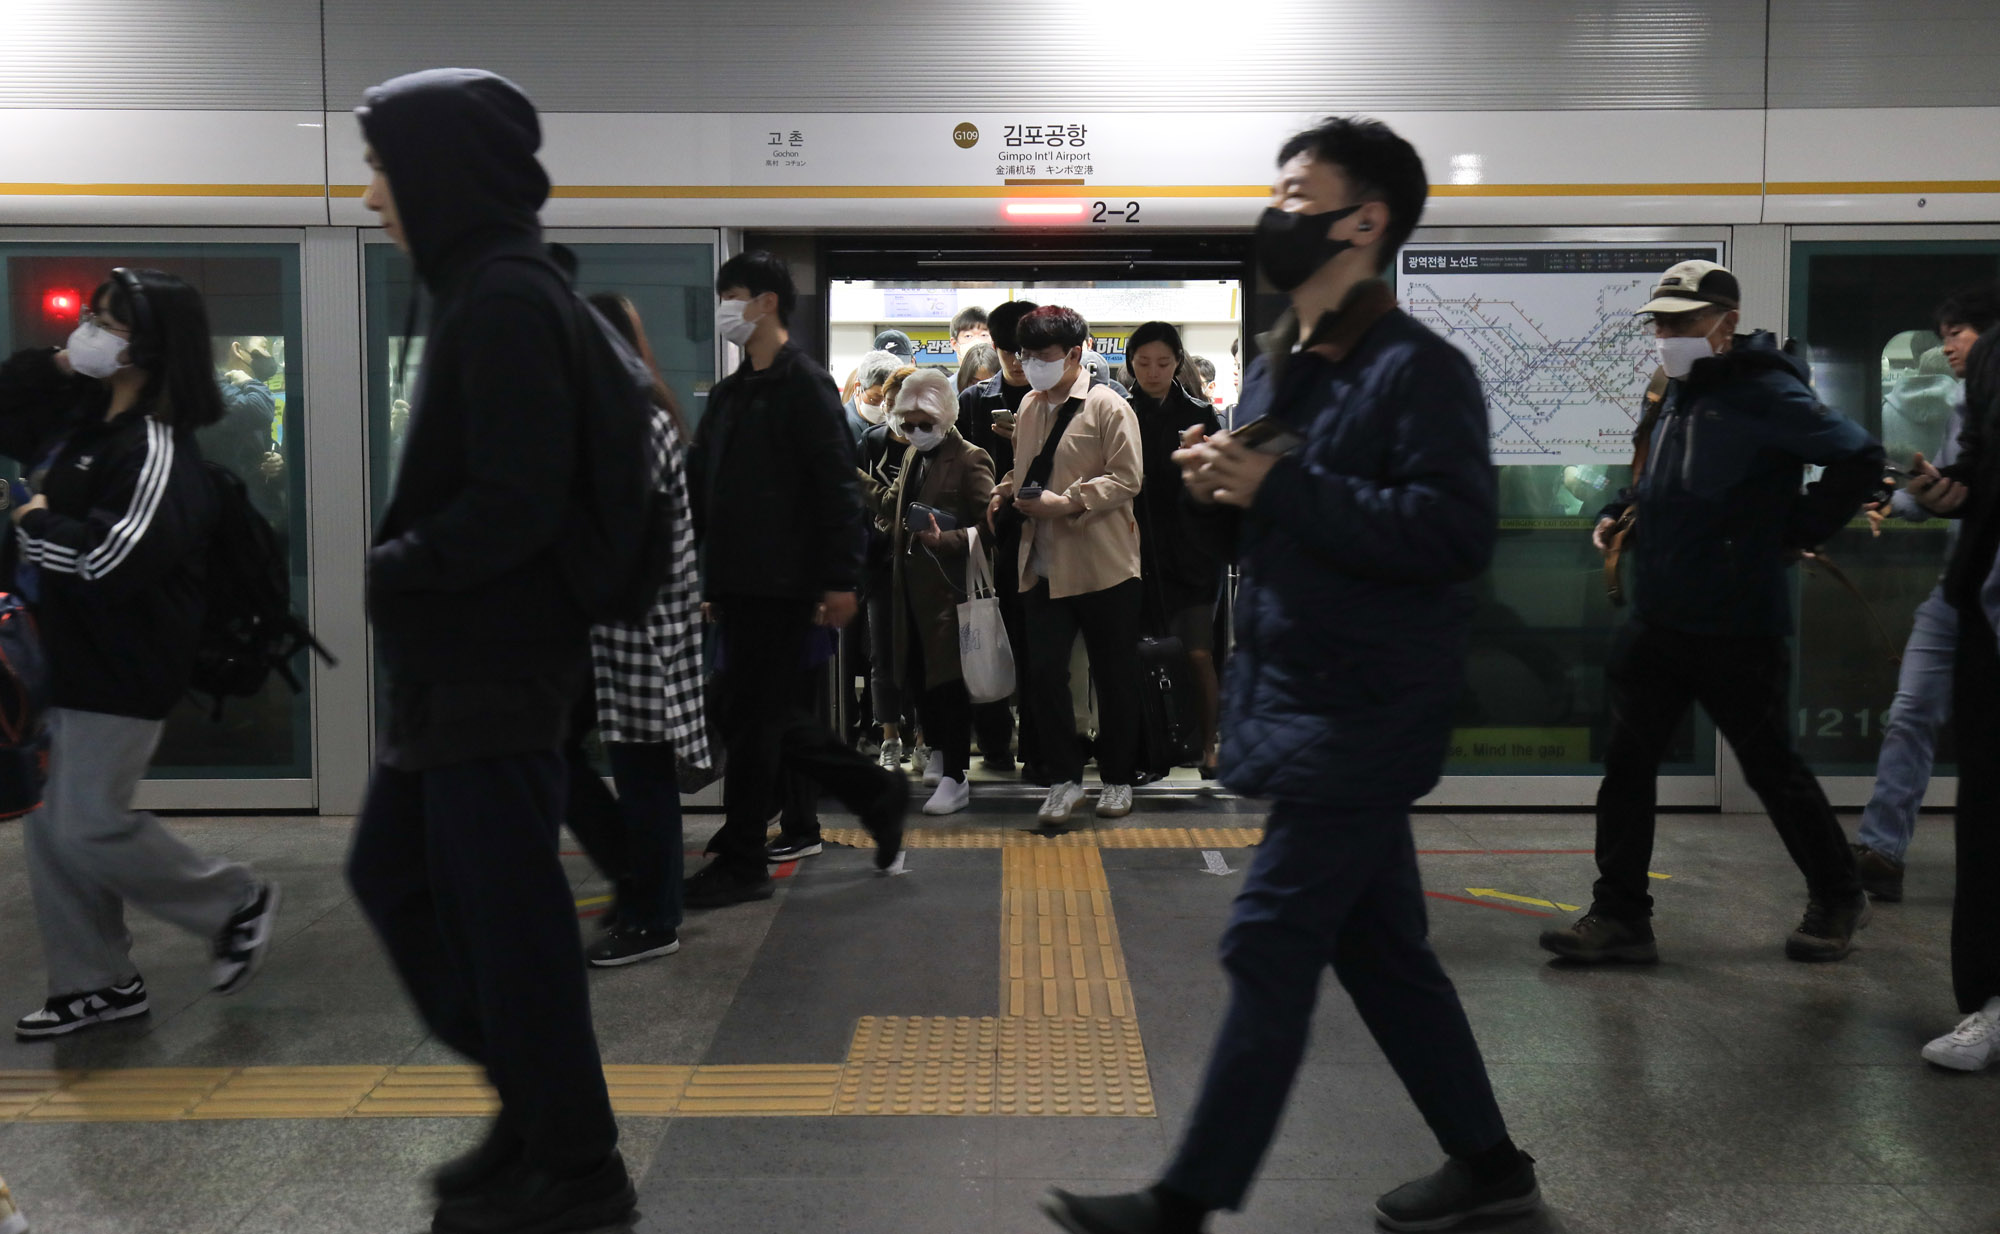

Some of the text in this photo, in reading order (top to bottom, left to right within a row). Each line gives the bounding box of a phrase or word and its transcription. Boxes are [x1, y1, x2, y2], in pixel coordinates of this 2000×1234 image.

[954, 131, 978, 141] G109
[1003, 124, 1088, 147] 김포공항
[772, 150, 799, 158] Gochon
[998, 151, 1091, 162] Gimpo Int'l Airport
[995, 165, 1036, 175] 金浦机场
[1092, 201, 1140, 223] 2-2
[1408, 256, 1447, 269] 광역전철
[1449, 256, 1479, 268] 노선도
[1473, 743, 1507, 757] Mind
[1511, 743, 1533, 757] the
[1537, 745, 1566, 759] gap
